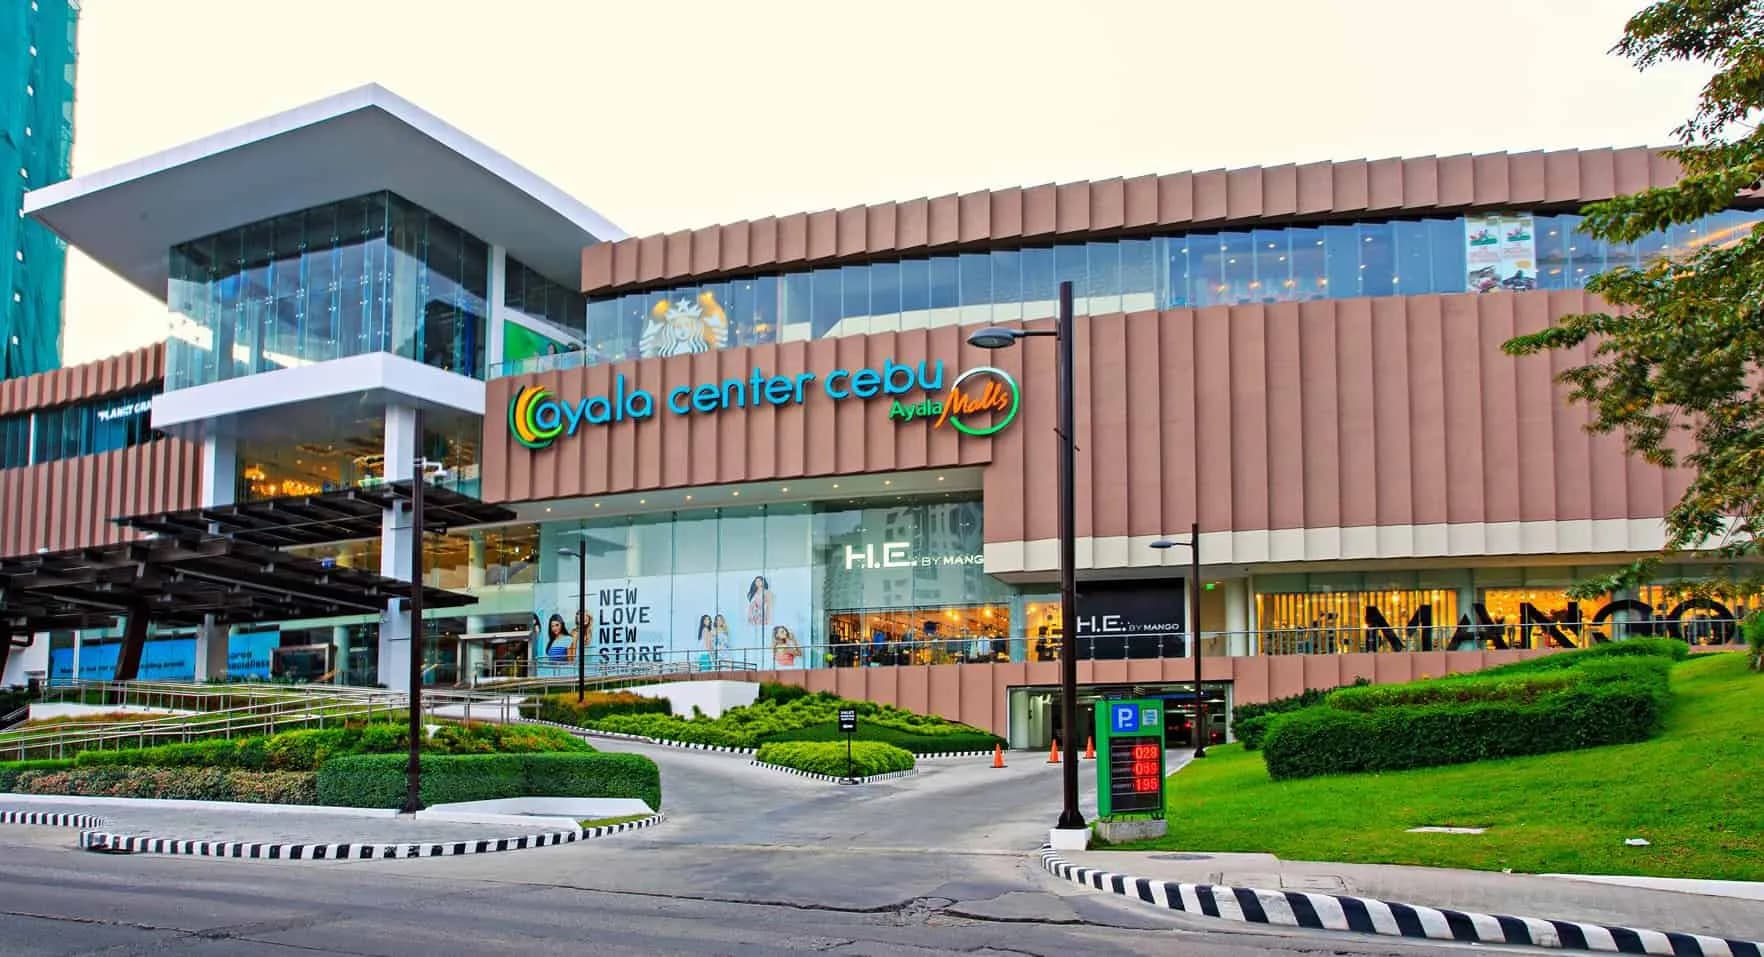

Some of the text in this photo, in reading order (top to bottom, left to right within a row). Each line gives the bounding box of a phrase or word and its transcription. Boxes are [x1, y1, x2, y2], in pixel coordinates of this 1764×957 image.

[535, 357, 944, 437] ayala center cebu
[888, 379, 1009, 430] Ayala Malls
[845, 541, 984, 569] H.E. BY MANG
[599, 587, 638, 606] NEW
[599, 606, 650, 626] LOVE
[1076, 614, 1127, 633] H.E.
[1143, 623, 1180, 632] MANGO
[1365, 599, 1736, 652] MANGO
[599, 626, 638, 644] NEW
[599, 645, 664, 664] STORE
[1118, 707, 1134, 729] P
